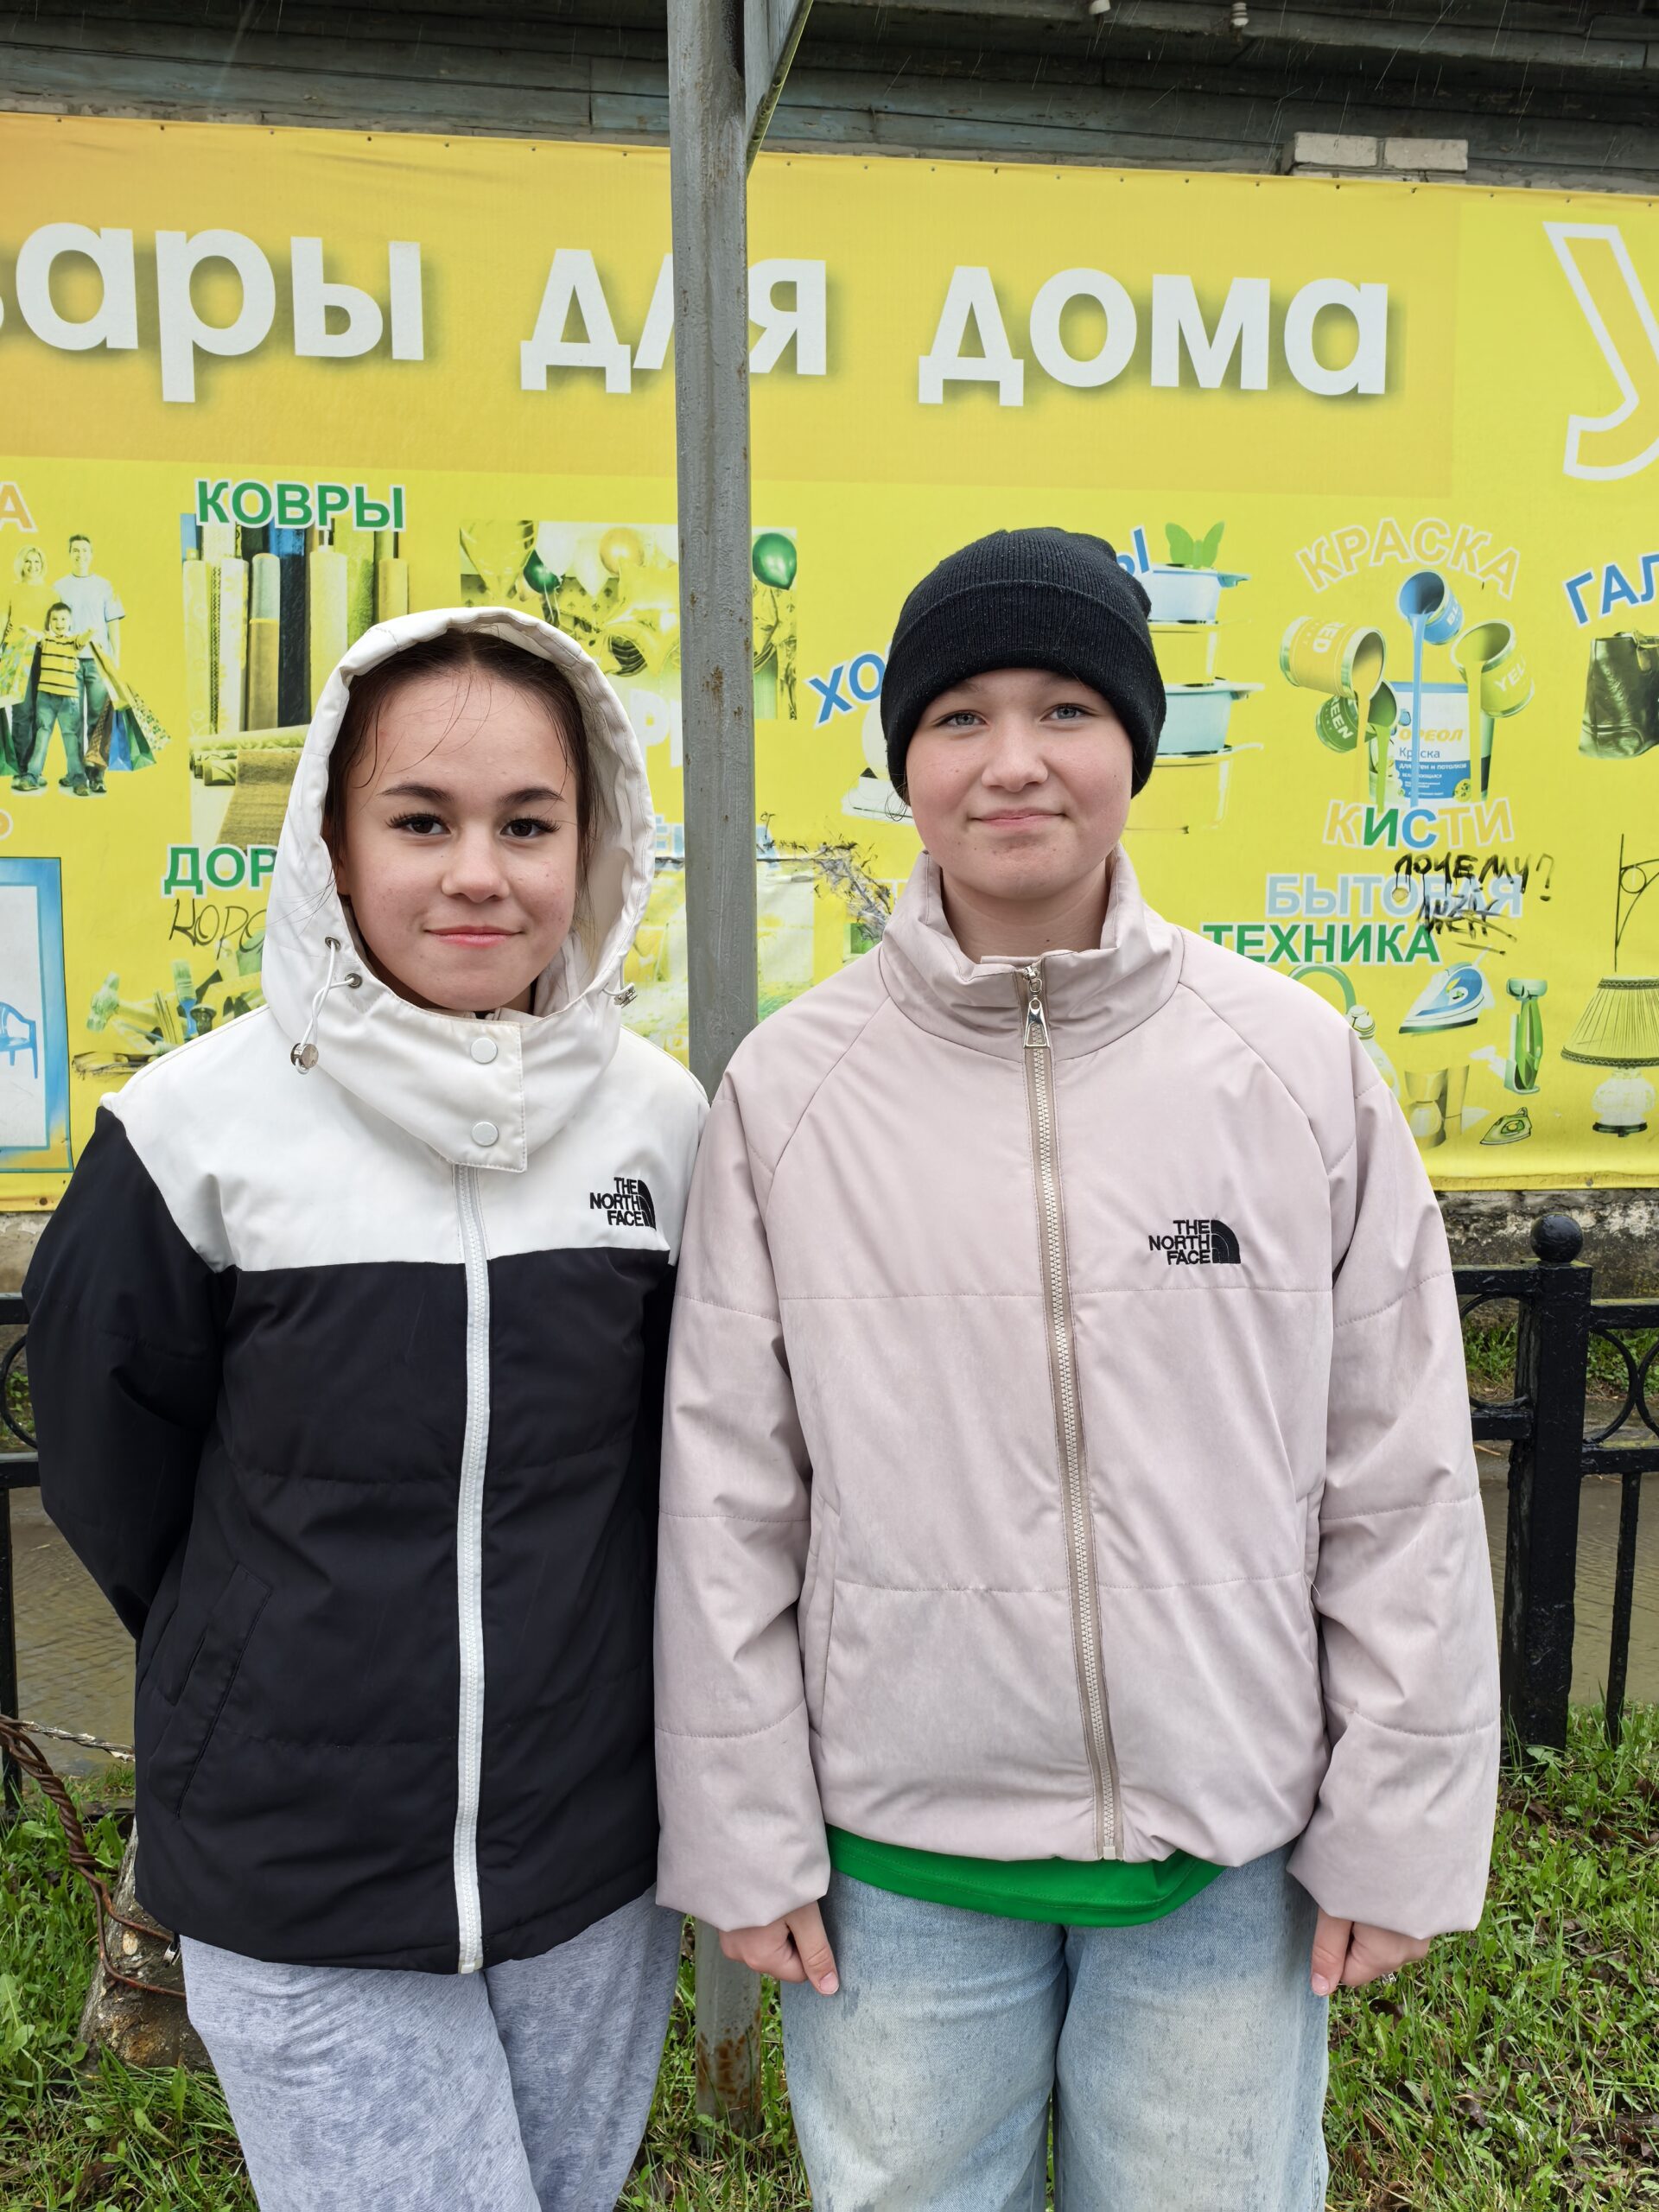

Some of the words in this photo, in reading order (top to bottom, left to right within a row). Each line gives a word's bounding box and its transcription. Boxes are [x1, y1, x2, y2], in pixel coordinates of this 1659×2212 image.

[0, 222, 424, 403] ары
[918, 265, 1389, 409] дома
[196, 479, 406, 532] КОВРЫ
[1297, 518, 1519, 600] КРАСКА
[1399, 747, 1440, 760] Крска
[1324, 798, 1515, 848] КИСТИ
[1202, 924, 1440, 963] ТЕХНИКА
[613, 1176, 639, 1195] THE
[589, 1192, 641, 1211] NORTH
[607, 1210, 645, 1227] FACE
[1173, 1219, 1210, 1235] THE
[1148, 1234, 1210, 1251] NORTH
[1166, 1249, 1211, 1265] FACE
